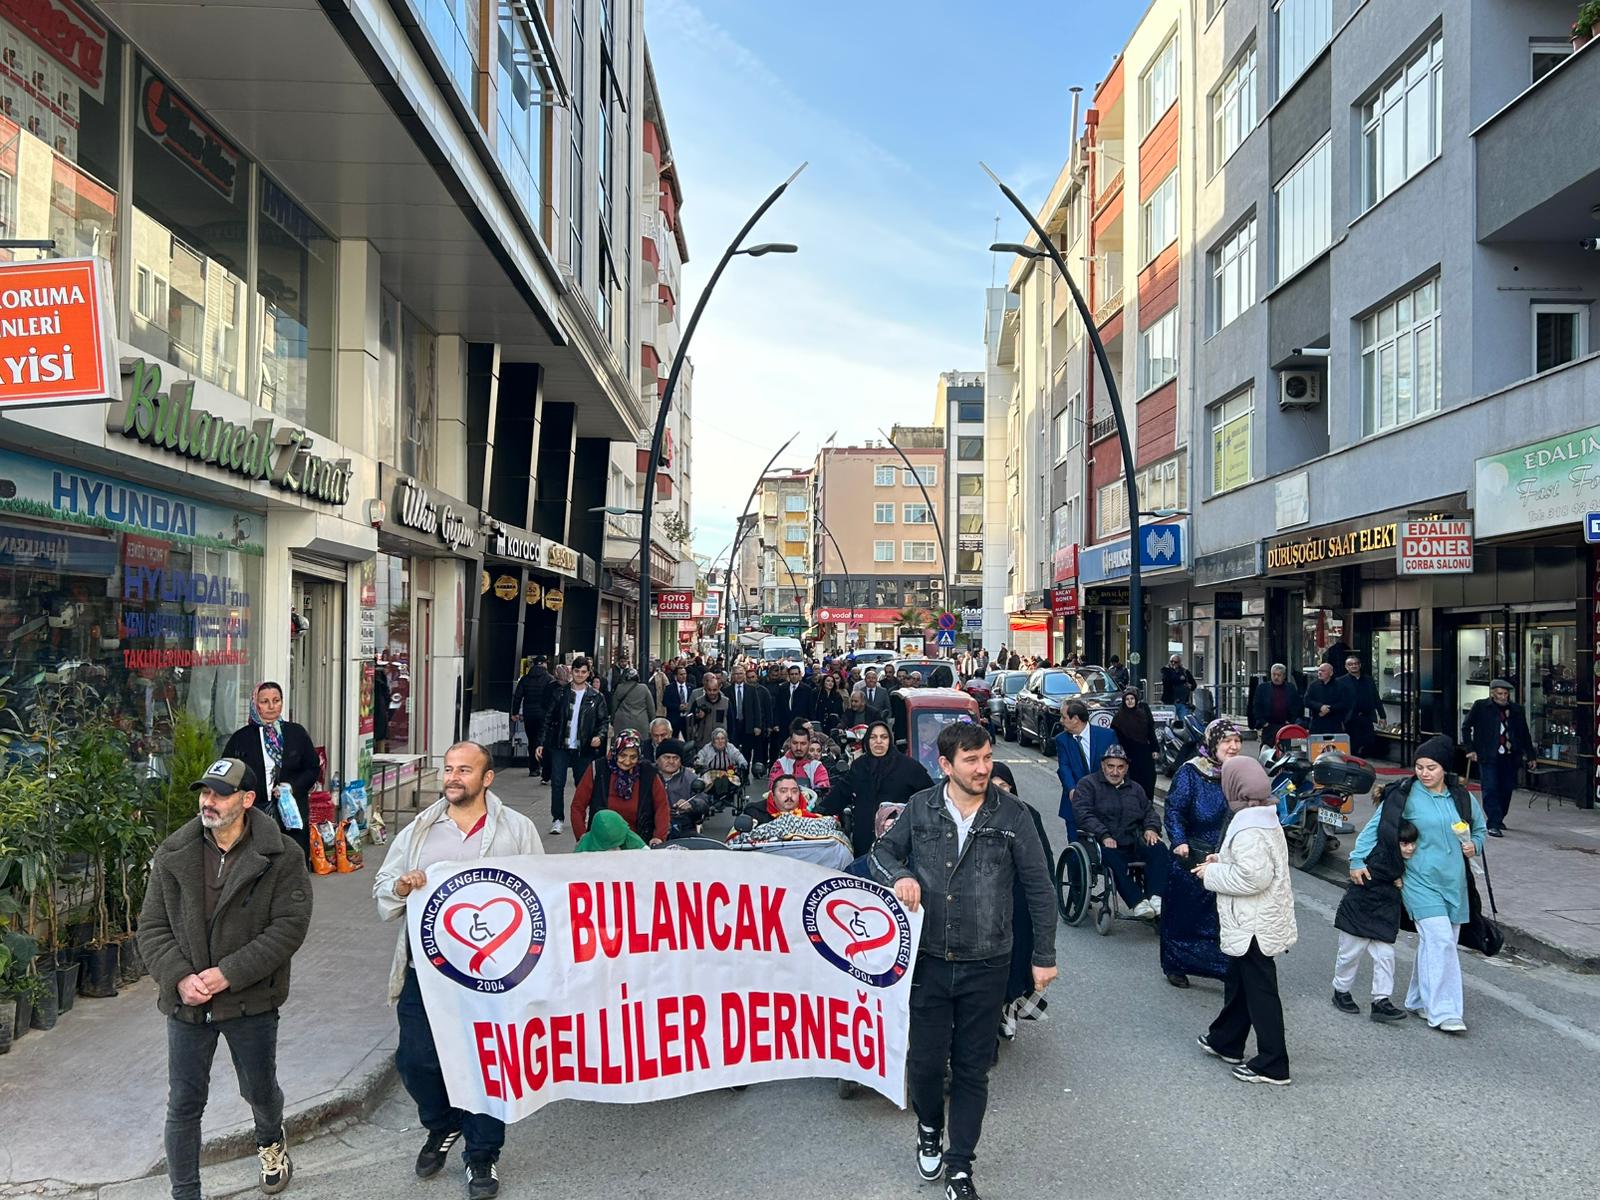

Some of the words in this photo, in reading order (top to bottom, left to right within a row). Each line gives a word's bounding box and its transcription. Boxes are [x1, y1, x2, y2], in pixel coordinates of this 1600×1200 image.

[0, 285, 86, 309] ORUMA
[0, 310, 62, 338] NLERİ
[118, 357, 275, 481] Bulancak
[52, 470, 197, 537] HYUNDAI
[402, 478, 438, 534] Ülkü
[442, 504, 475, 551] Giyim
[1408, 522, 1466, 536] EDALIM
[1267, 536, 1326, 568] DÜBÜŞOĞLU
[1328, 532, 1358, 558] SAAT
[1406, 538, 1470, 556] DÖNER
[1405, 559, 1435, 572] ÇORBA
[1436, 558, 1471, 570] SALONU
[660, 602, 690, 611] GÜNEŞ
[662, 594, 687, 602] FOTO
[422, 891, 449, 956] BULANCAK
[447, 870, 522, 893] ENGELLİLER
[519, 888, 546, 942] DERNEĞİ
[805, 884, 832, 932] BULANCAK
[568, 881, 790, 964] BULANCAK
[476, 980, 505, 991] 2004
[848, 964, 874, 985] 2004
[473, 982, 710, 1101] ENGELLİLER
[720, 988, 886, 1078] DERNEĞİ
